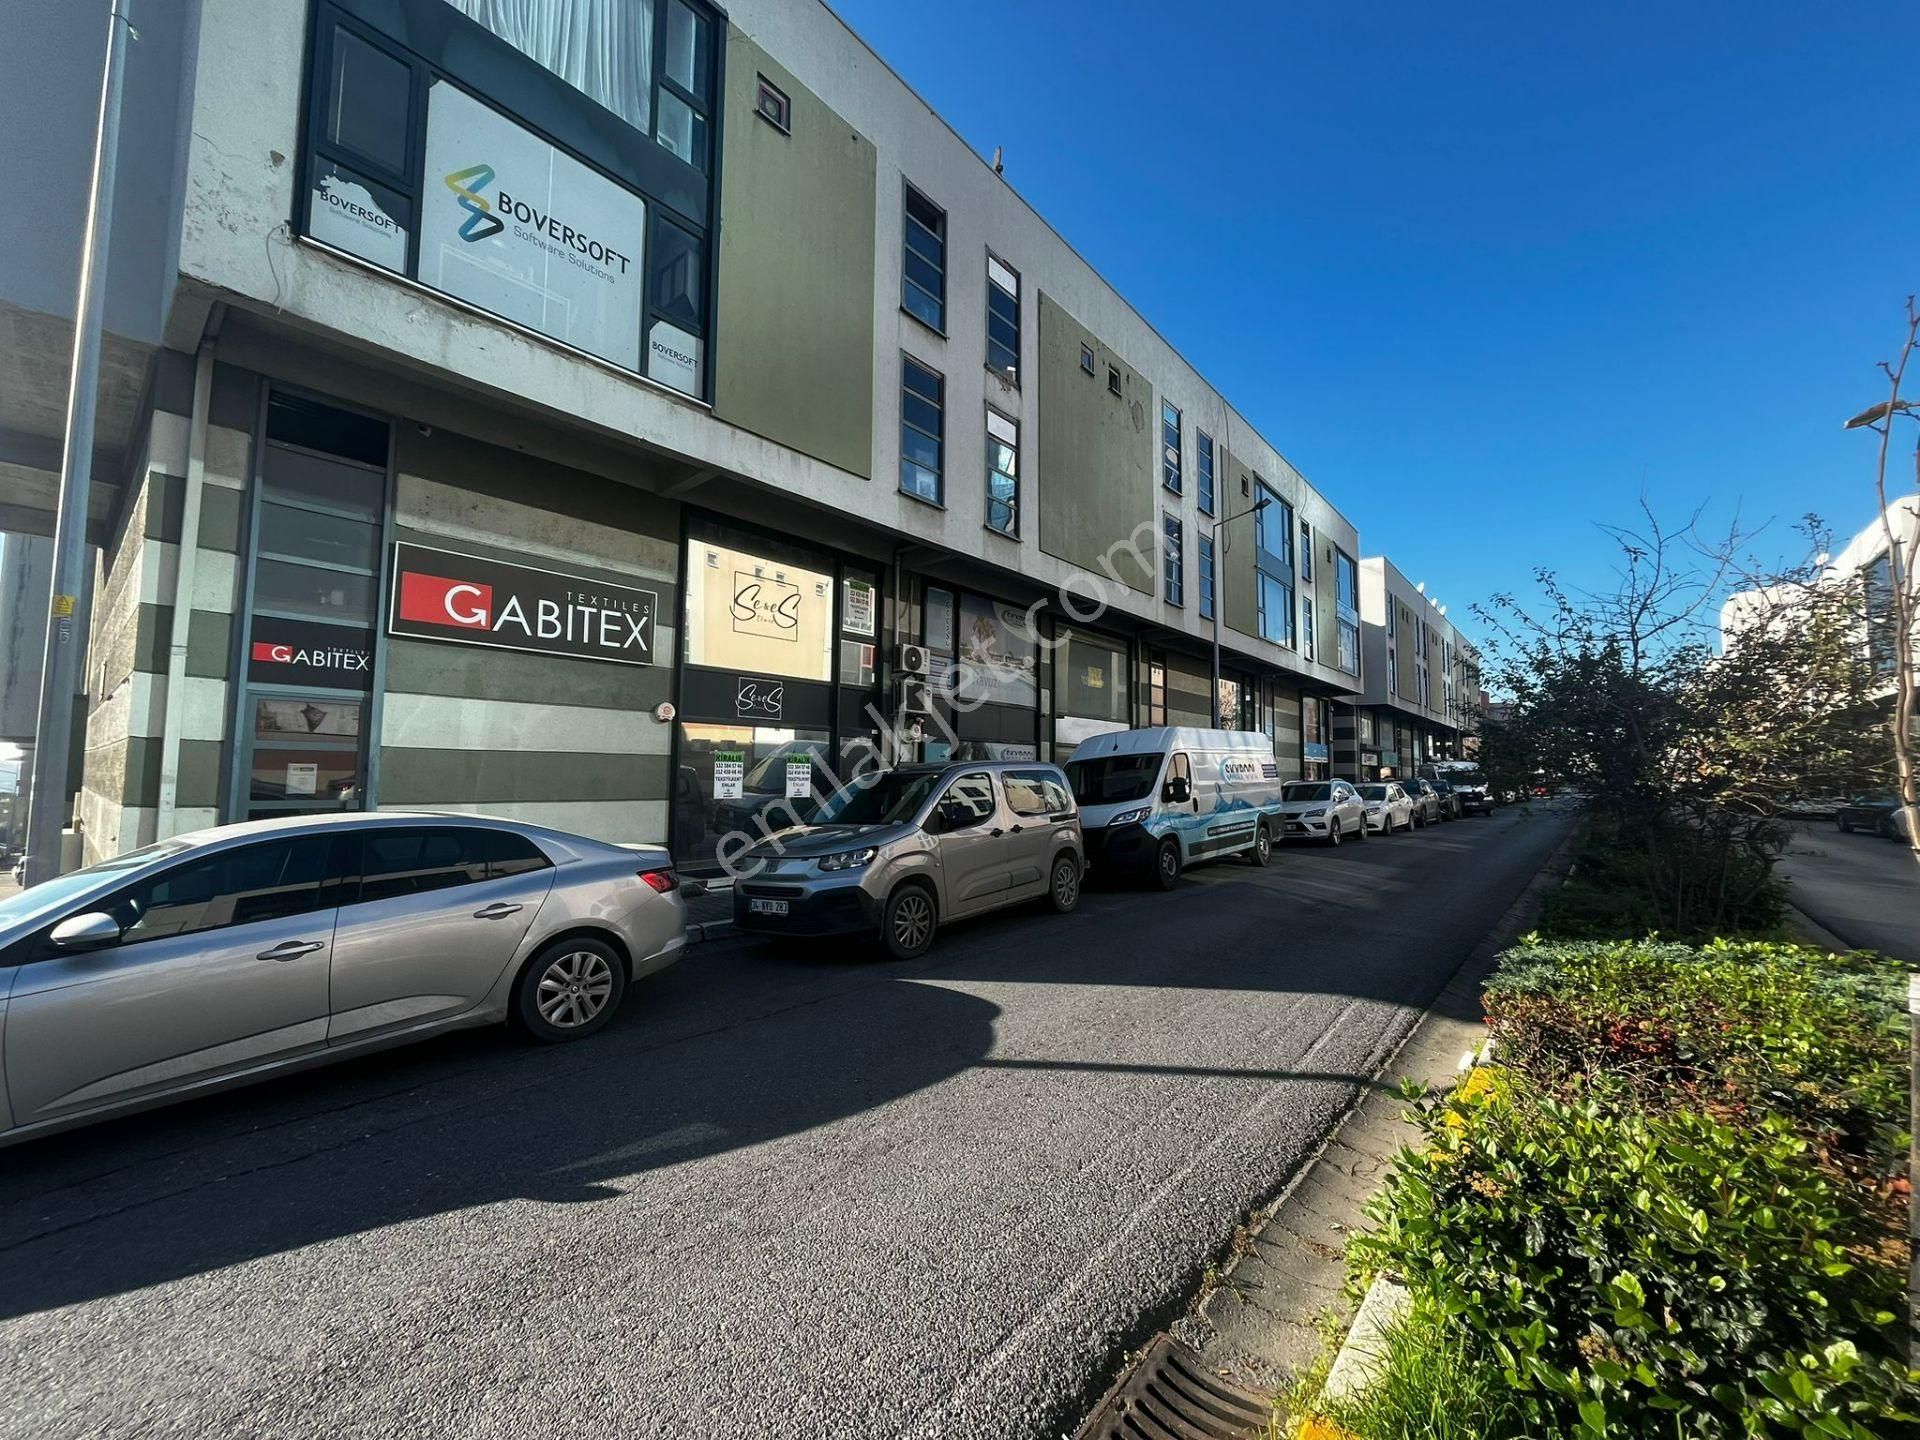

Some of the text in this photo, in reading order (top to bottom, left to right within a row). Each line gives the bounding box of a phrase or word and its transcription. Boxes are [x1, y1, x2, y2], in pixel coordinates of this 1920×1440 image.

[320, 190, 399, 234] BOVERSOFT
[498, 191, 631, 275] BOVERSOFT
[513, 225, 616, 285] Software Solutions
[652, 341, 698, 368] BOVERSOFT
[444, 584, 649, 651] GABITEX
[566, 591, 651, 614] TEXTILES
[271, 645, 370, 671] GABITEX
